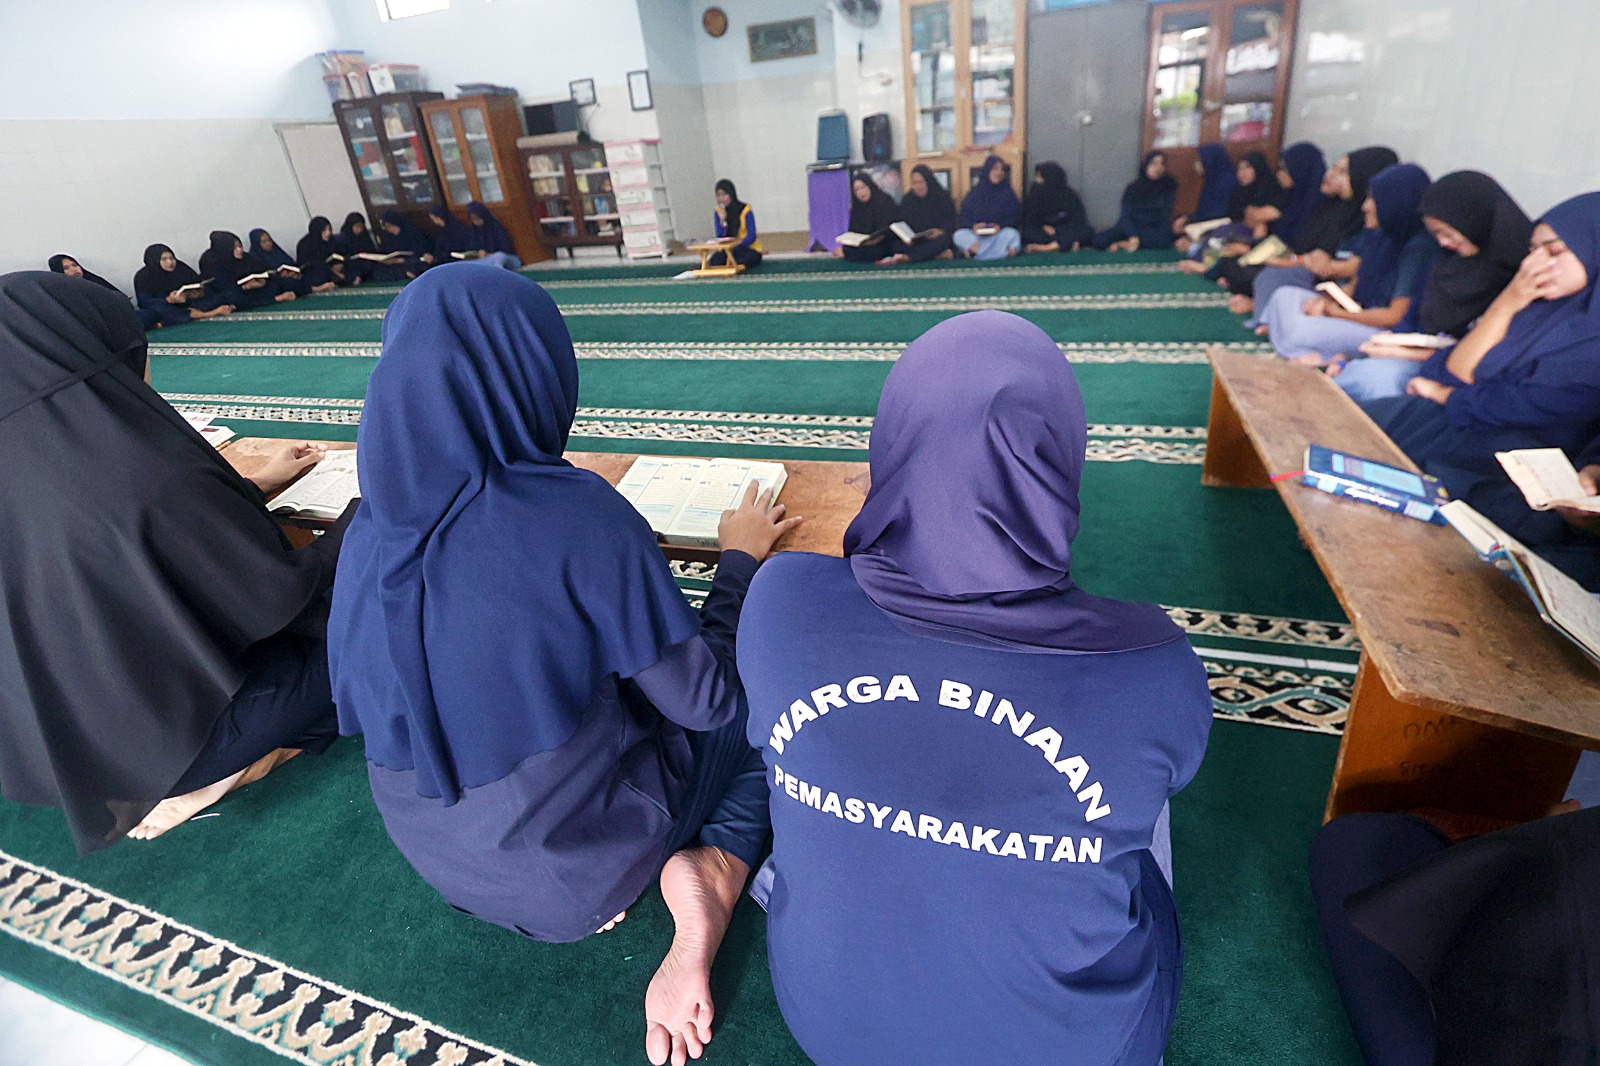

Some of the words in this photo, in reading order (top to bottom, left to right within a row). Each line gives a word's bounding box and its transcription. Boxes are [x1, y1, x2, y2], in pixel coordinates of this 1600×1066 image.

[769, 675, 919, 755] WARGA
[939, 679, 1111, 822] BINAAN
[774, 764, 1102, 863] PEMASYARAKATAN
